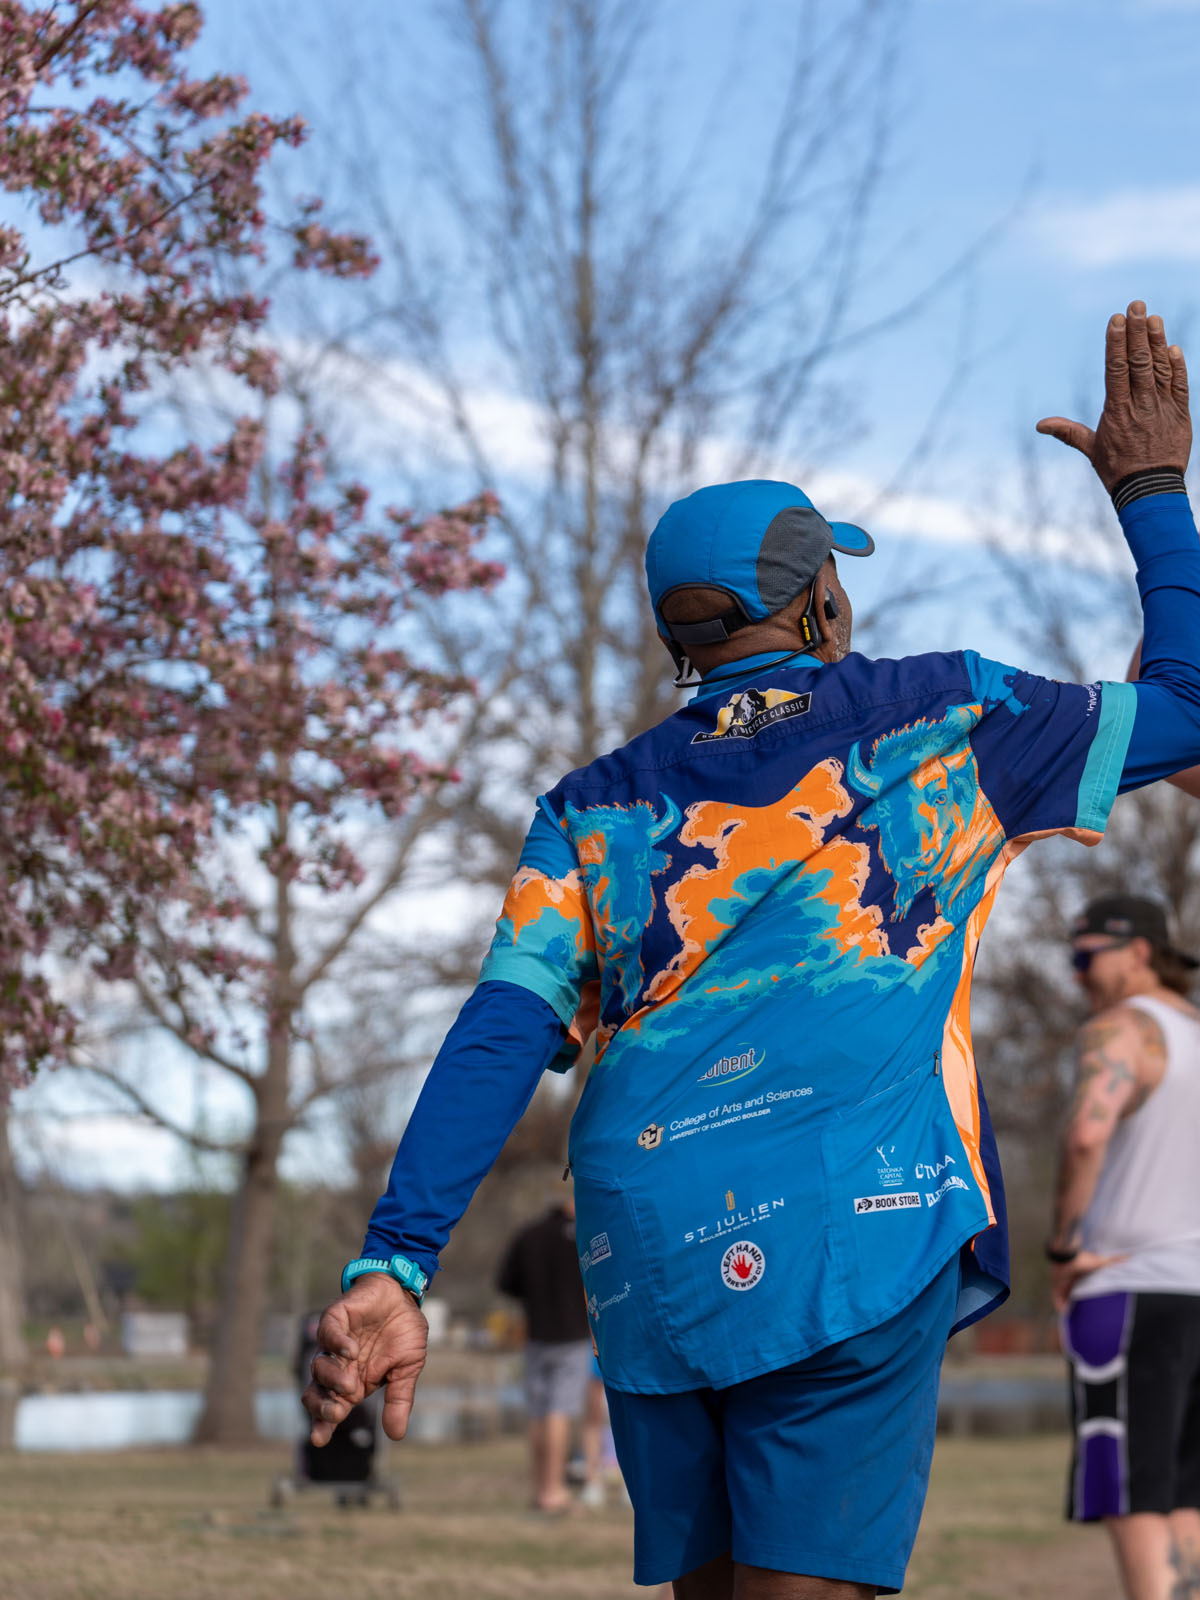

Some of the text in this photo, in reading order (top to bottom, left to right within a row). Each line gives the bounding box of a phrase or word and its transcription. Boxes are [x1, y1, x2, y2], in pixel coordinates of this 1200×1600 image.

[769, 700, 805, 719] CLASSIC
[669, 1086, 813, 1131] College of Arts and Sciences
[669, 1108, 771, 1142] UNIVERSITY OF COLORADO BOULDER
[875, 1194, 920, 1209] BOOK STORE
[684, 1197, 785, 1243] ST JULIEN
[723, 1243, 763, 1275] LEFT HAND
[726, 1274, 758, 1288] BREWING
